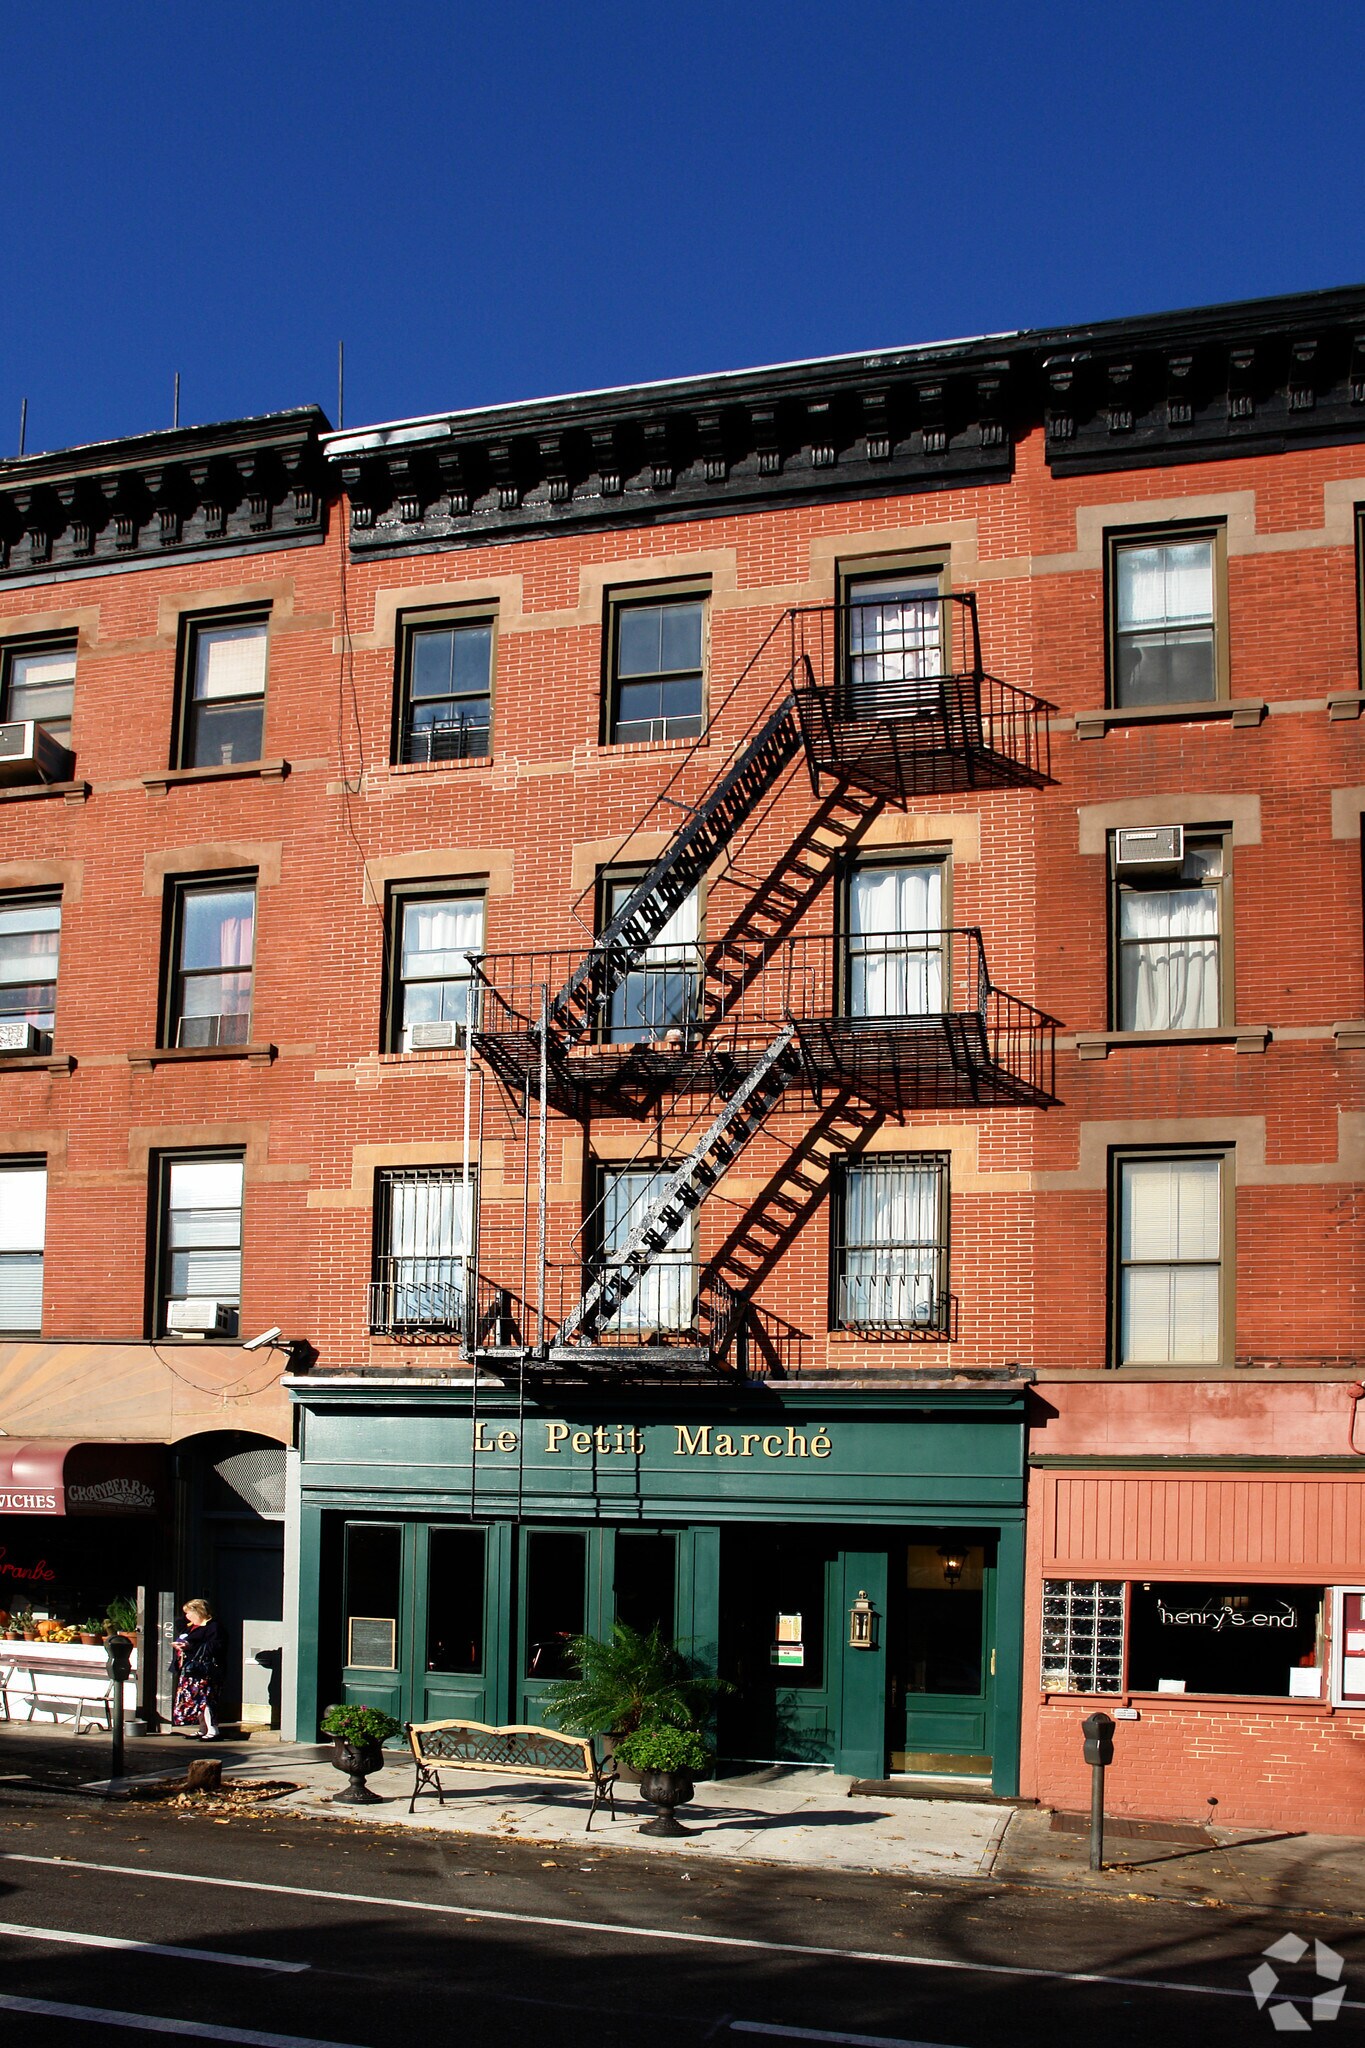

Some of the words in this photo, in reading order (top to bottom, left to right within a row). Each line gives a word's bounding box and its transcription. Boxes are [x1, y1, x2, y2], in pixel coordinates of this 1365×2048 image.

[473, 1421, 518, 1452] Le
[544, 1423, 646, 1455] Petit
[673, 1425, 833, 1458] Marché
[1159, 1606, 1246, 1629] henry's
[1252, 1611, 1294, 1628] end
